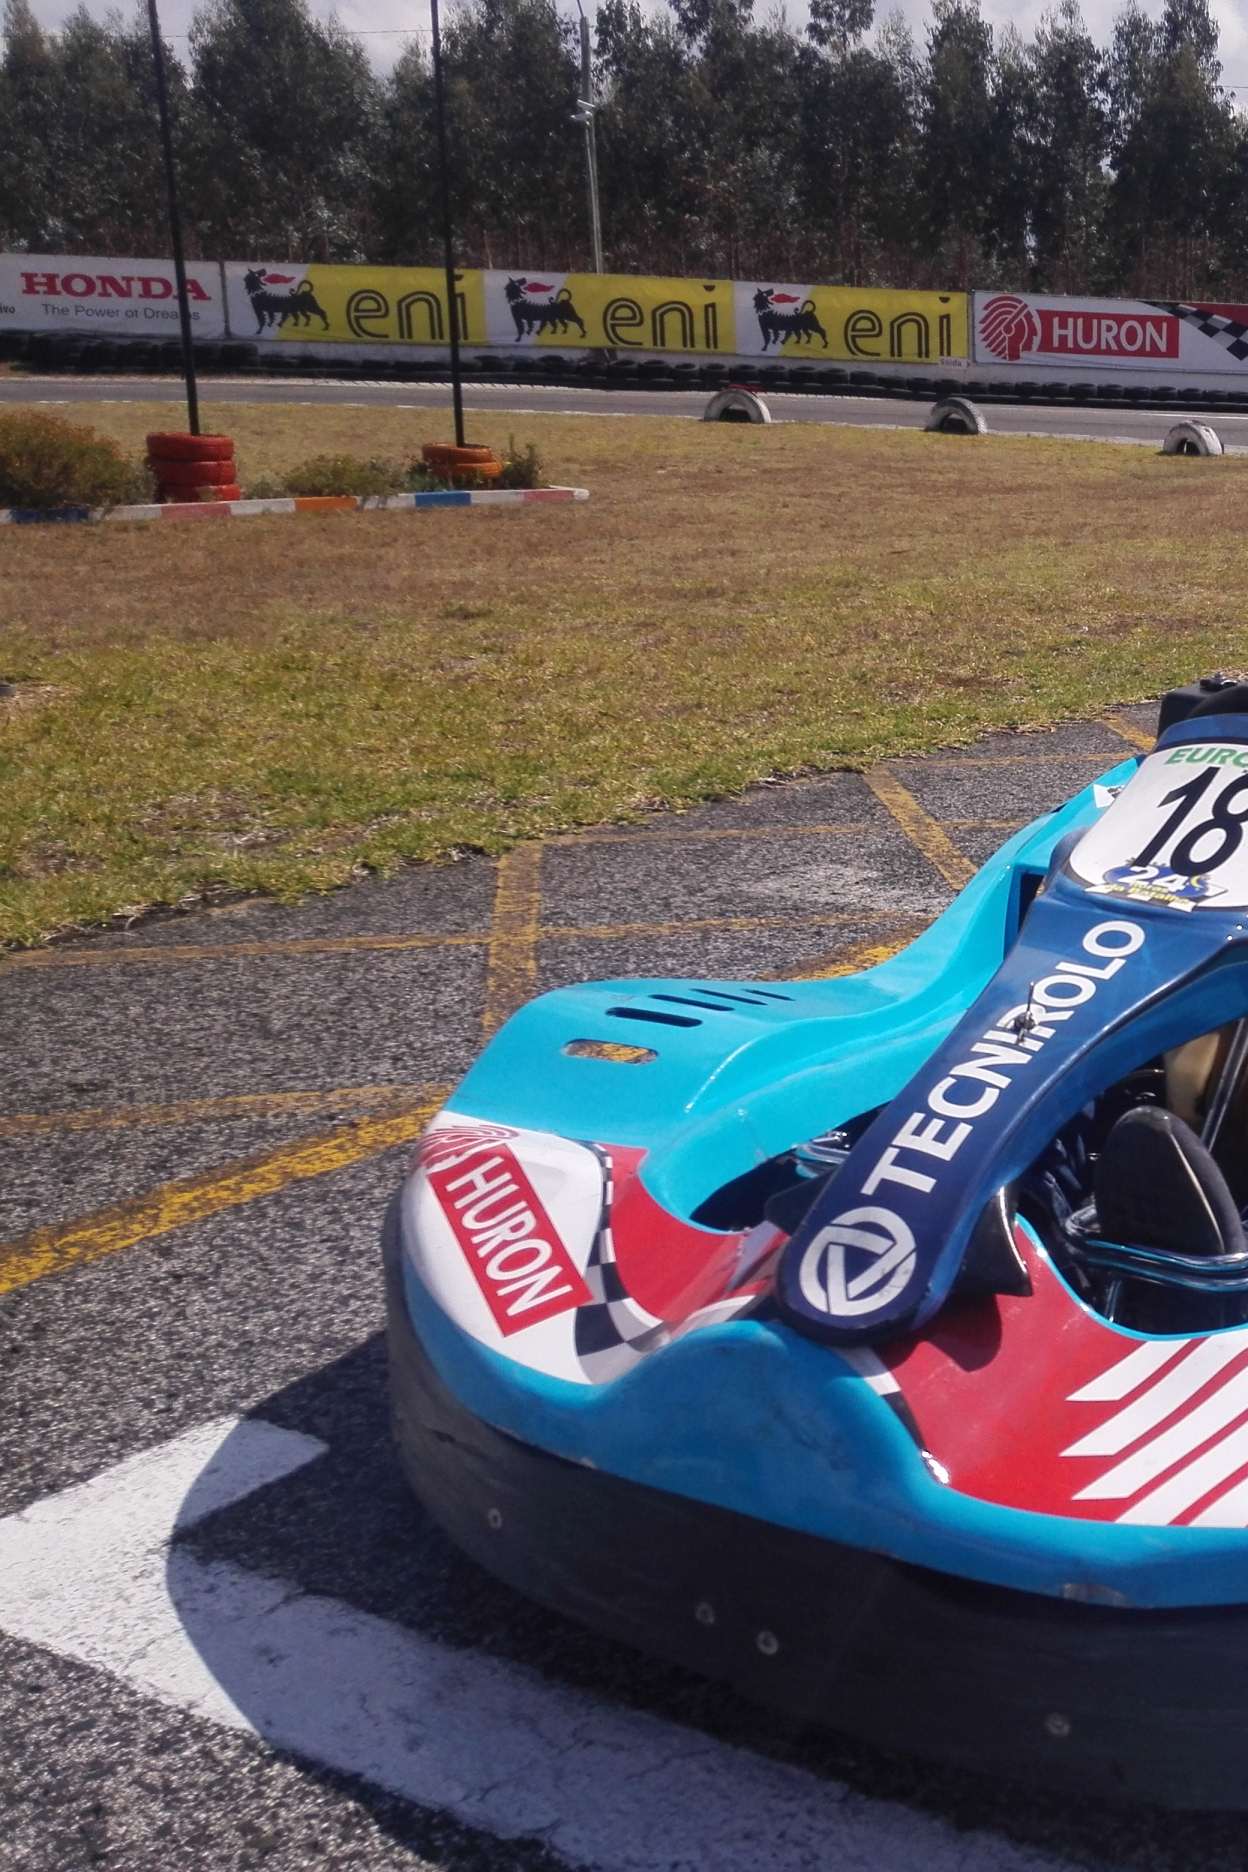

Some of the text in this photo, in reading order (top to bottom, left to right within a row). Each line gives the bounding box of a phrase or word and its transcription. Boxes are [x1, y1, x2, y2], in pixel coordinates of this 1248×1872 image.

[20, 272, 212, 301] HONDA
[42, 303, 70, 316] The
[74, 305, 119, 318] Power
[143, 308, 200, 321] Dreas
[345, 274, 469, 341] eni
[602, 285, 718, 349] eni
[843, 296, 953, 358] eni
[1052, 317, 1168, 353] HURON
[1117, 865, 1190, 892] 24
[859, 920, 1147, 1195] TECNIROLO
[445, 1156, 574, 1317] HURON
